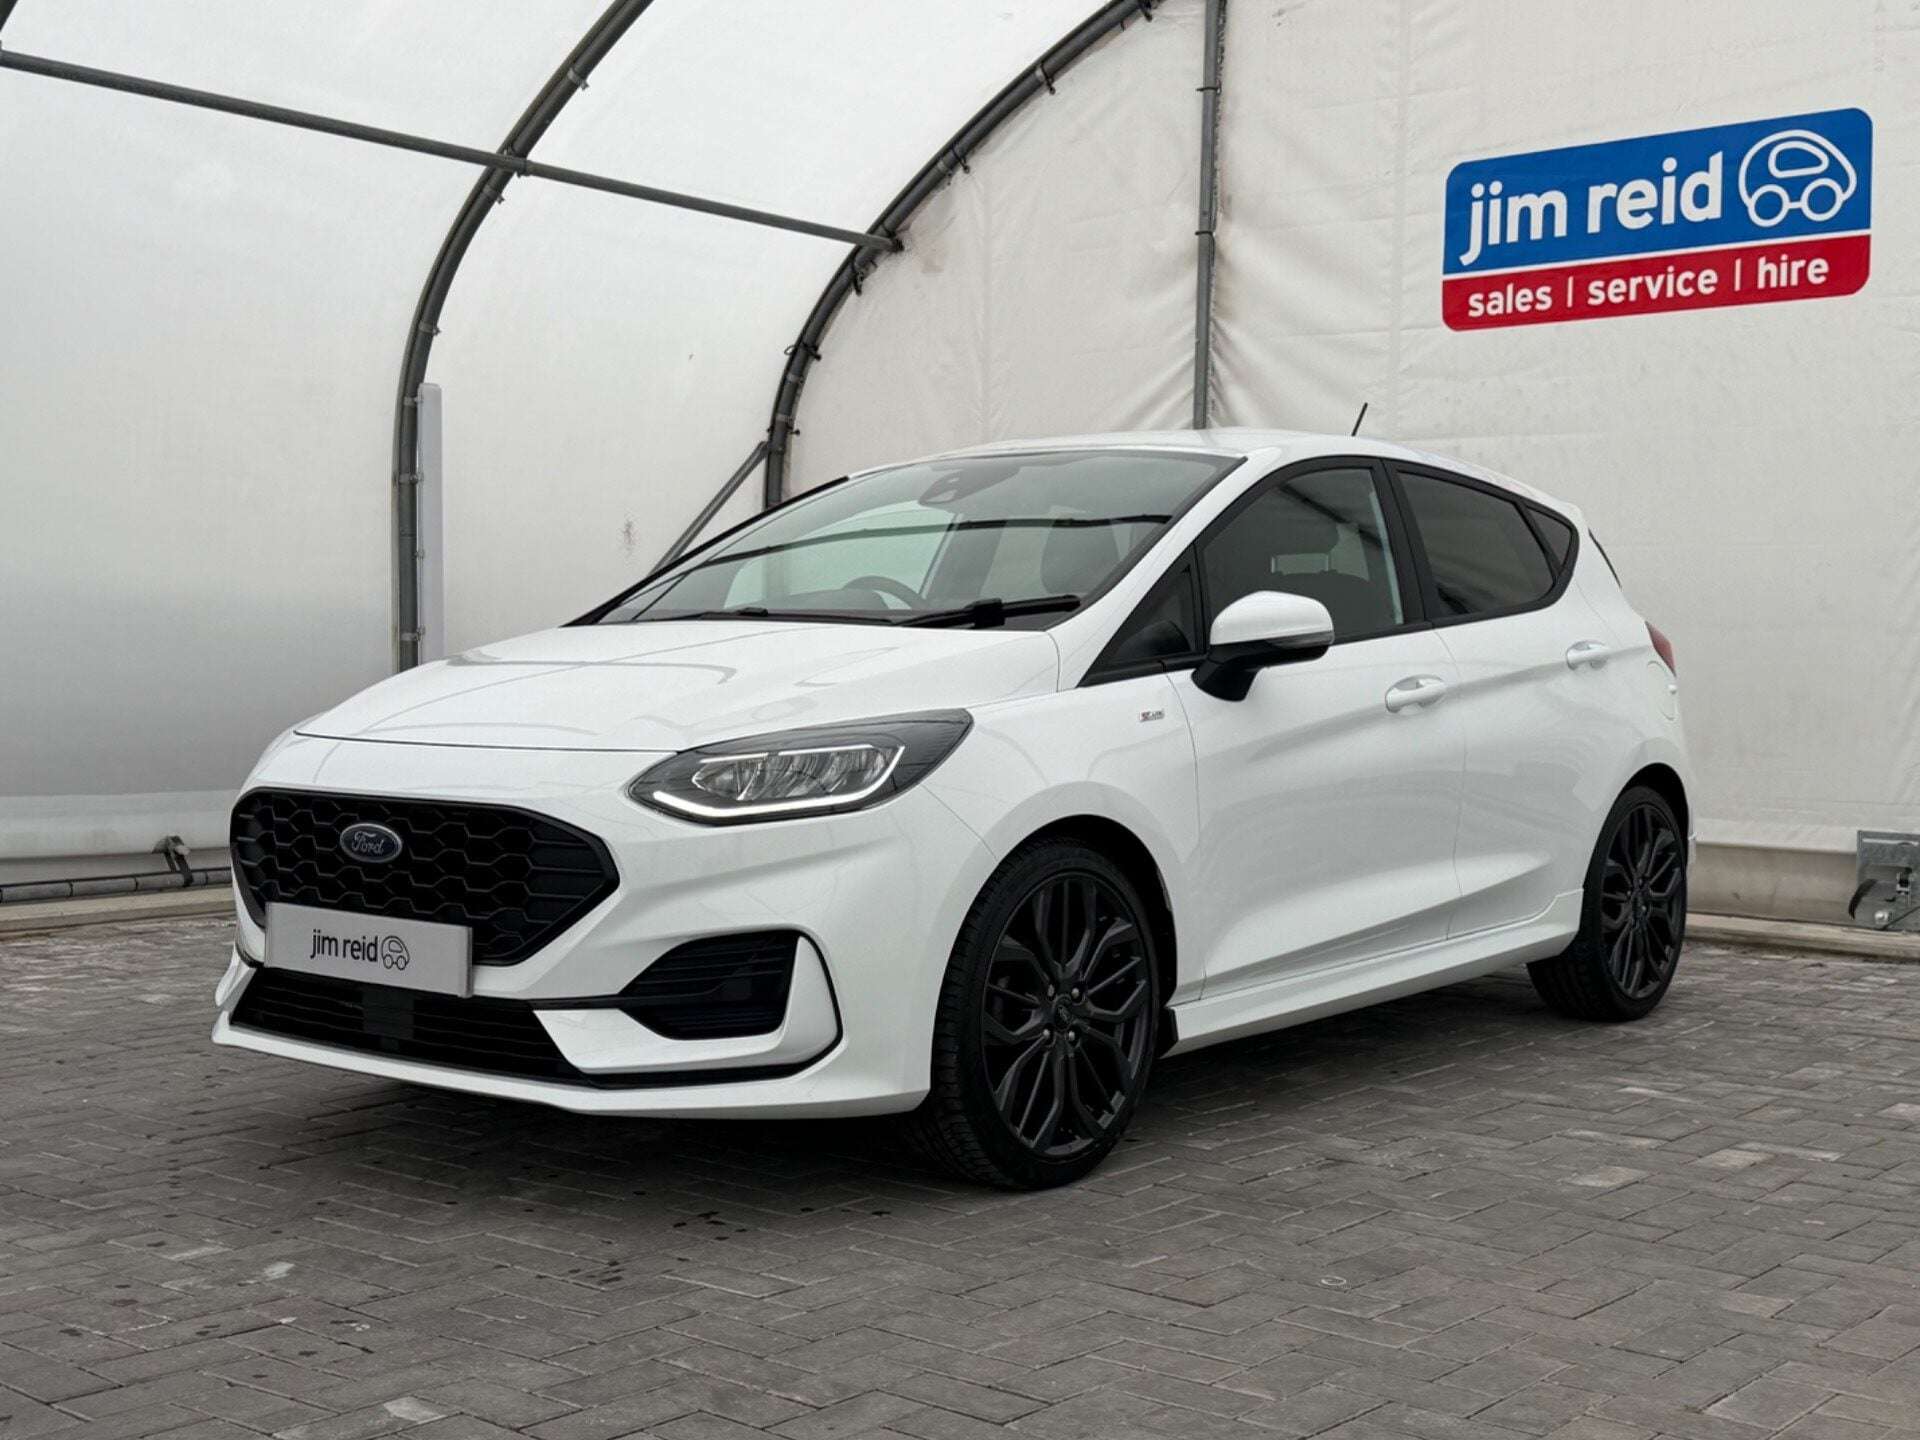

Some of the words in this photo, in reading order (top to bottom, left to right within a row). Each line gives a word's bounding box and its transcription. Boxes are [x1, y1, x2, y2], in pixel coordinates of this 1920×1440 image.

[1459, 180, 1567, 266] jim
[1587, 151, 1723, 235] reid
[1467, 282, 1552, 318] sales
[1587, 266, 1718, 306] service
[1756, 253, 1829, 289] hire
[351, 830, 384, 854] Ford
[310, 929, 339, 960] jim
[342, 935, 378, 962] reid
